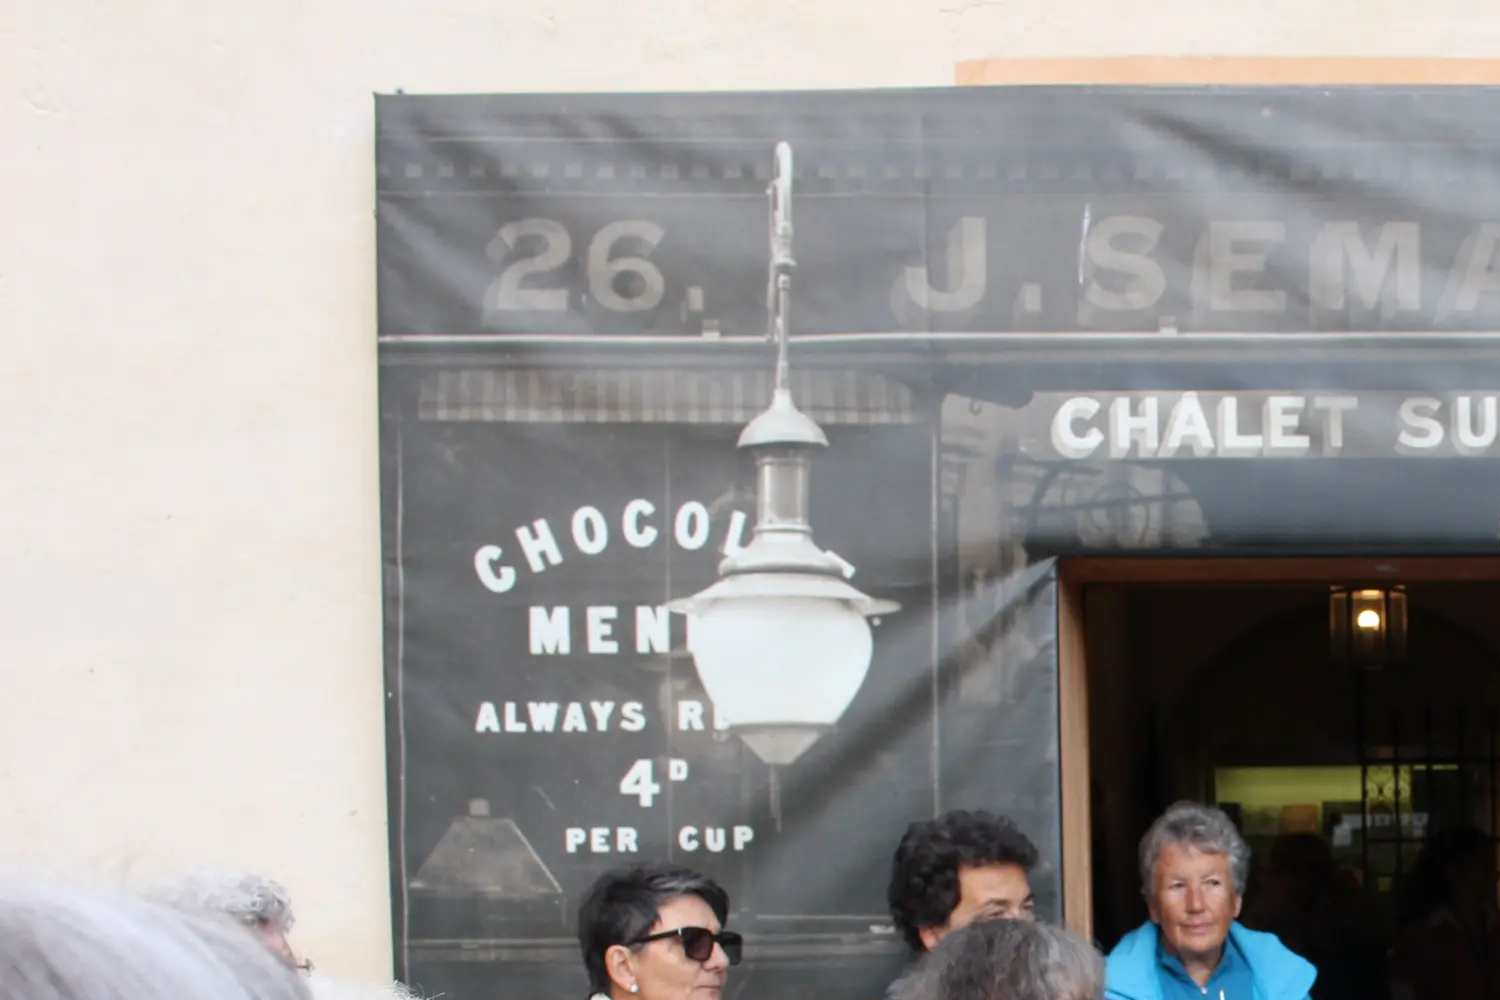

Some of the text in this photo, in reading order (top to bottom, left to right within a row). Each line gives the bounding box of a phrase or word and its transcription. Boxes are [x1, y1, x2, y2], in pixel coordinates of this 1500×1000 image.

[1050, 393, 1358, 459] CHALET
[474, 701, 647, 733] ALWAYS
[565, 824, 755, 853] PER CUP
